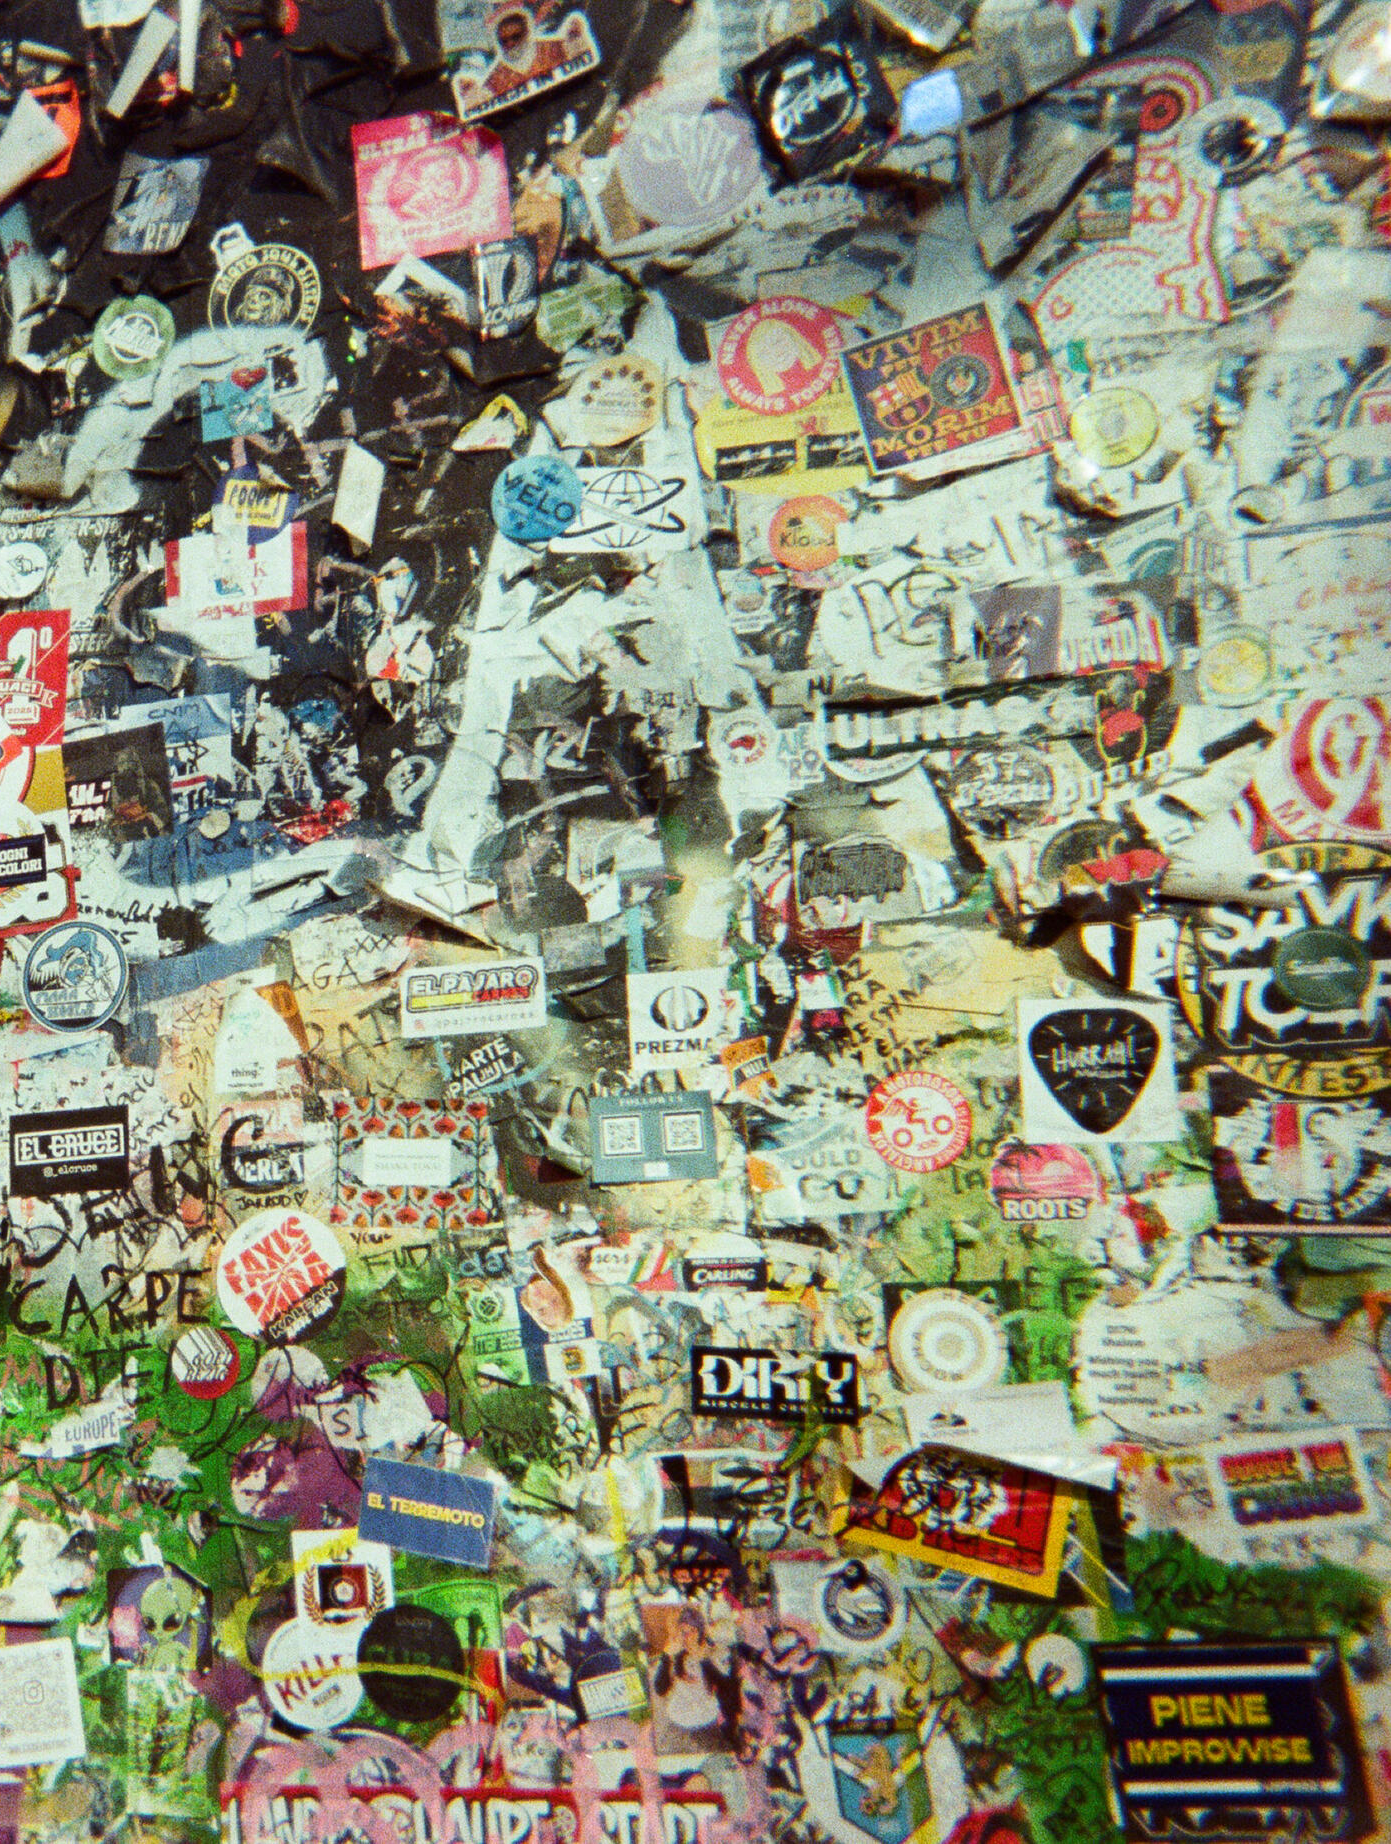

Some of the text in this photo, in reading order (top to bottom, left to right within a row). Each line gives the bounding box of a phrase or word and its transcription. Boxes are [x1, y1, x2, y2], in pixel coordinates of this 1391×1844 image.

[760, 302, 820, 321] ALONE
[720, 310, 758, 367] NEVER
[848, 310, 985, 369] VIVIM
[728, 377, 787, 412] ALWAYS
[871, 395, 1013, 458] MORIM
[411, 976, 439, 996] EL
[20, 1130, 119, 1160] EL CRUCE
[1001, 1198, 1088, 1220] ROOTS
[367, 1492, 486, 1529] EL TERREMOTO
[1150, 1694, 1271, 1728] PIENE
